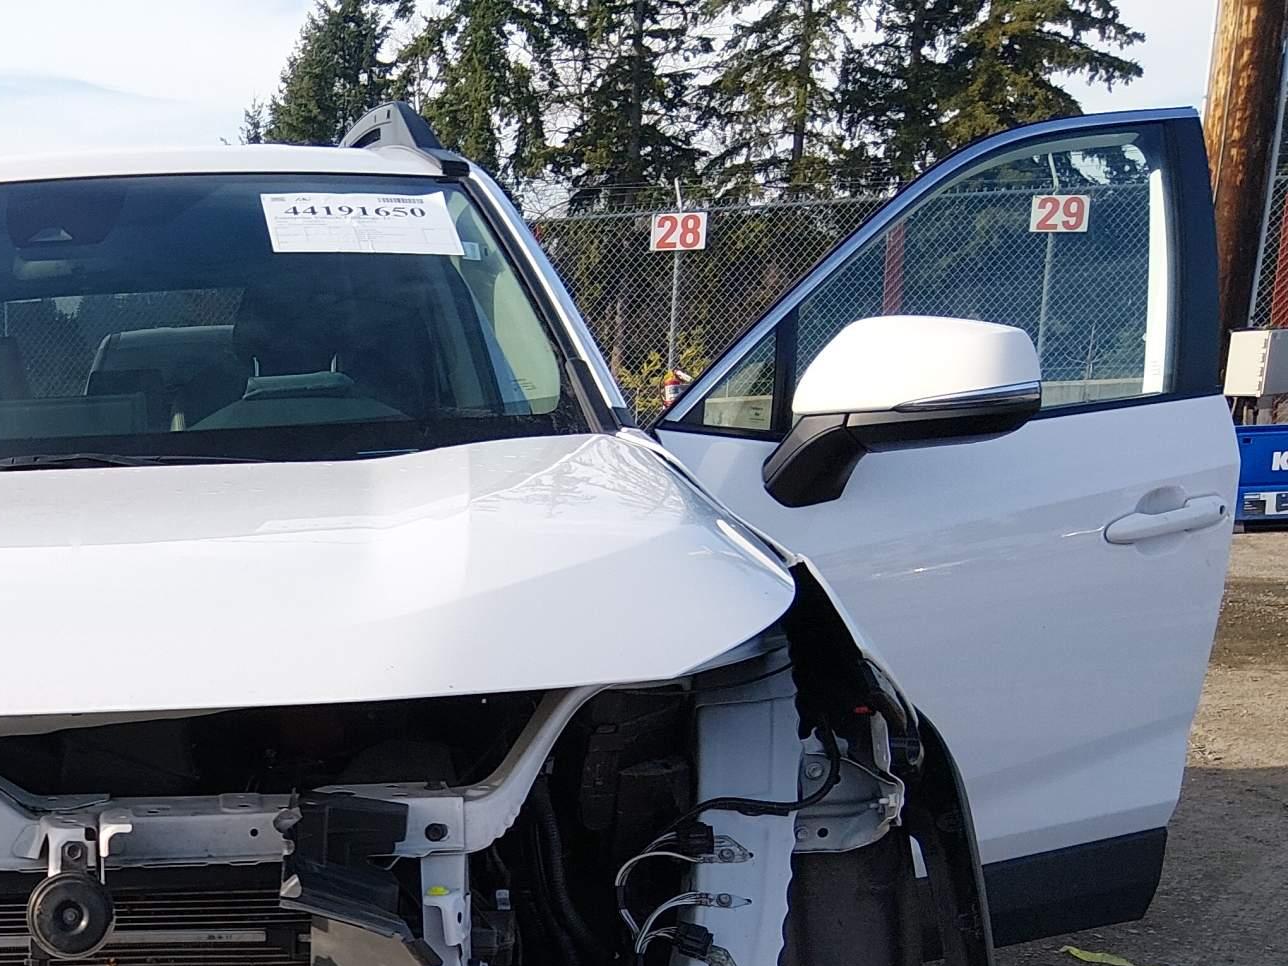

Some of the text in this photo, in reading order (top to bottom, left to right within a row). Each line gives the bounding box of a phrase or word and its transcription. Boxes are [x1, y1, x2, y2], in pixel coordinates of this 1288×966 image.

[283, 205, 427, 219] 44191650
[1036, 196, 1085, 231] 29
[656, 214, 701, 249] 28
